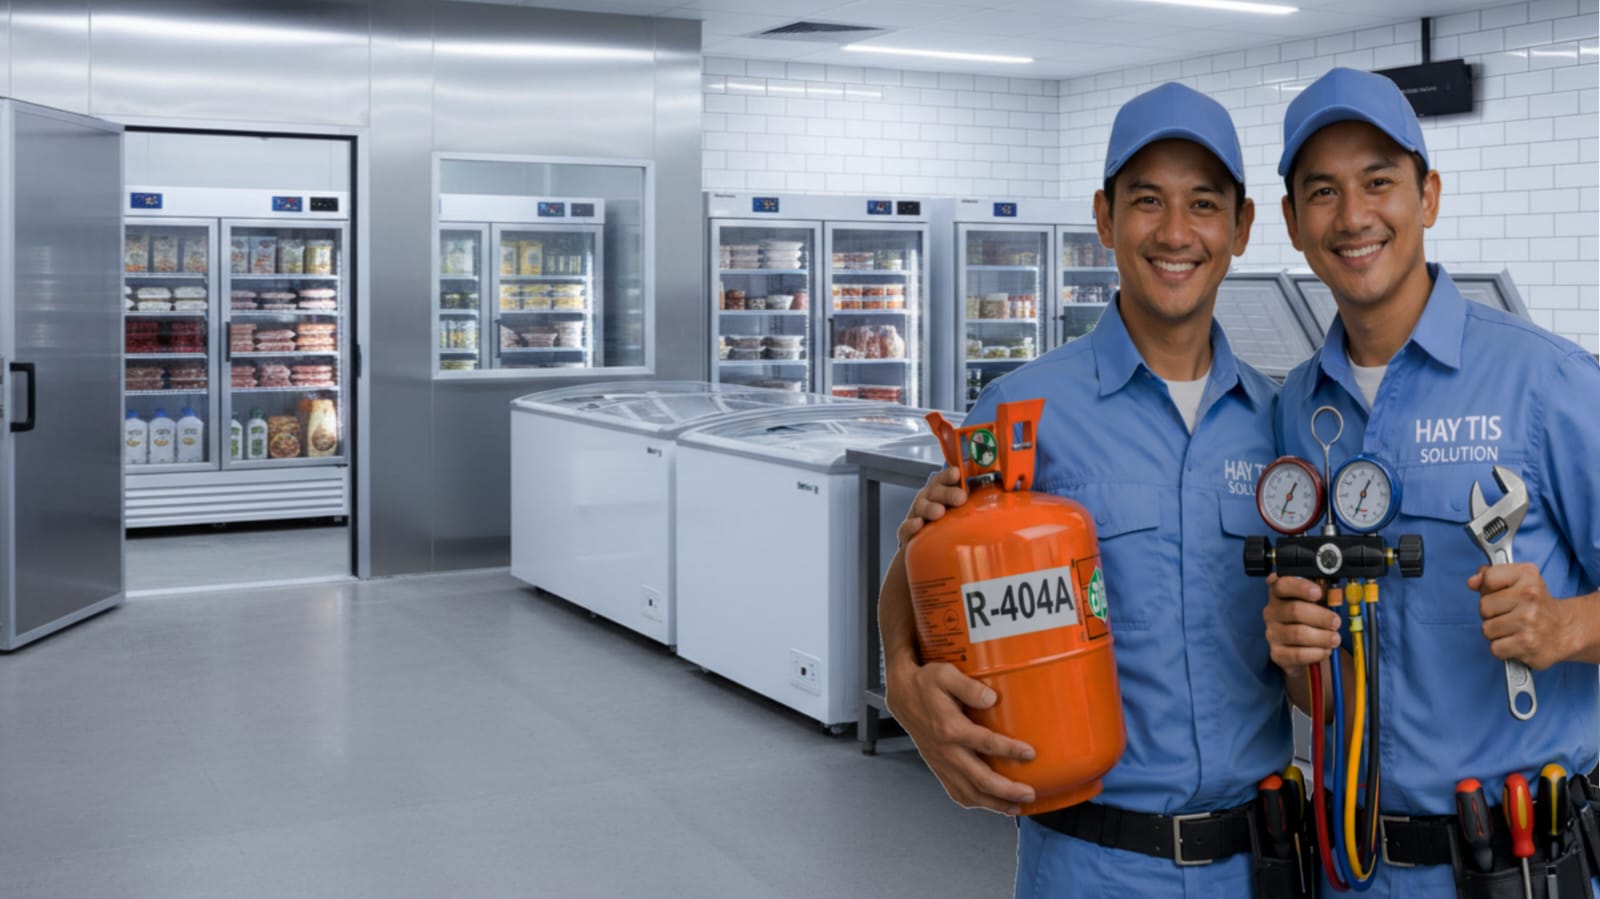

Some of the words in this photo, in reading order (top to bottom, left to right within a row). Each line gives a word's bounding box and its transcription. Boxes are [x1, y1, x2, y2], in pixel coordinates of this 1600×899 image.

[1416, 418, 1461, 443] HAY
[1465, 415, 1502, 440] TIS
[1421, 446, 1498, 463] SOLUTION
[1225, 460, 1252, 480] HAY
[1229, 481, 1256, 496] SOLU
[966, 576, 1074, 628] R-404A
